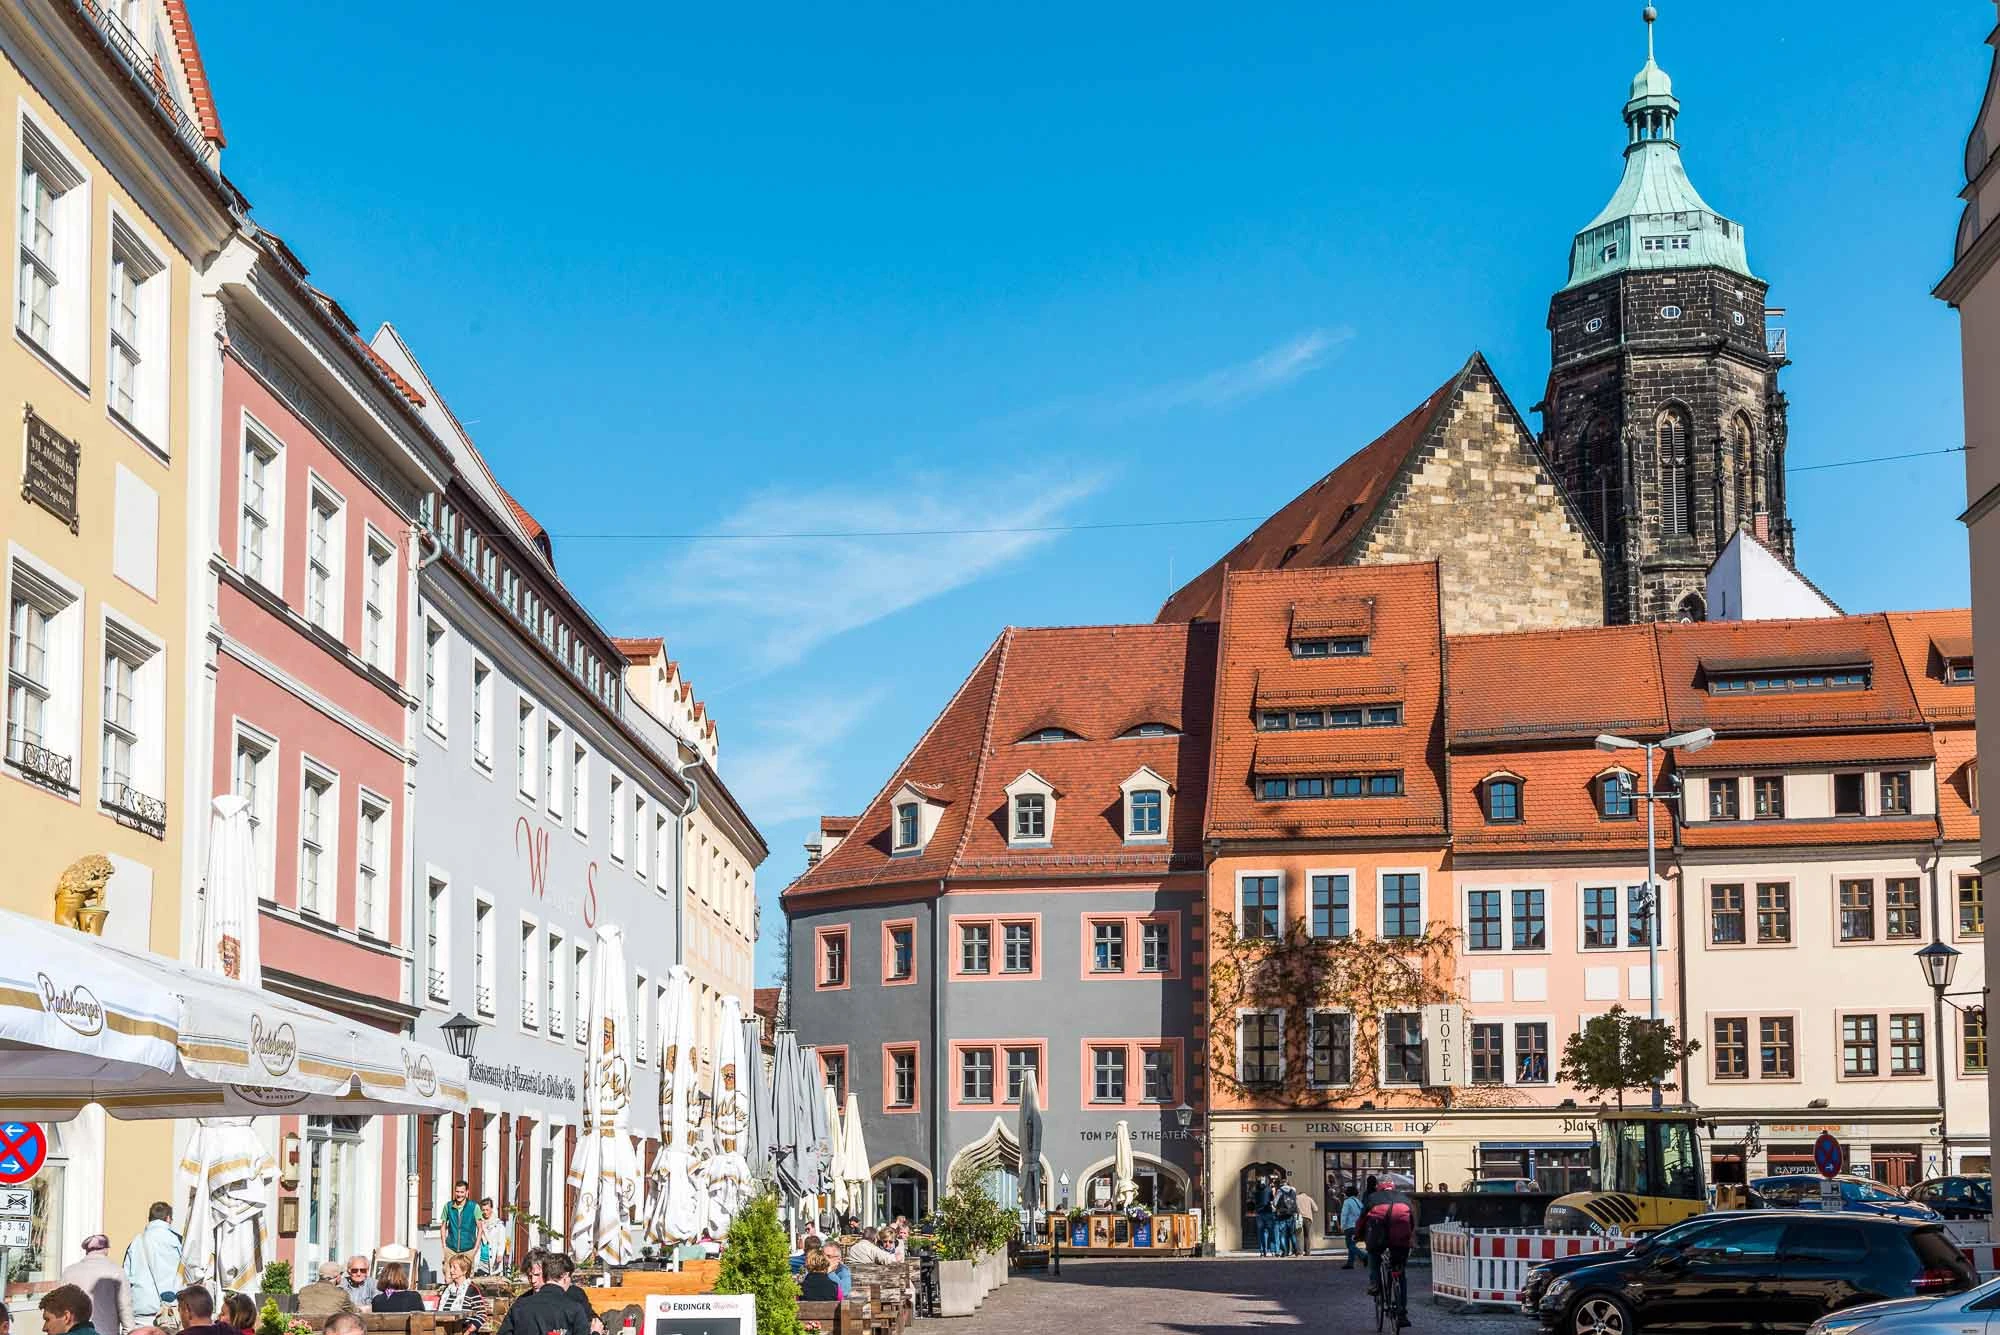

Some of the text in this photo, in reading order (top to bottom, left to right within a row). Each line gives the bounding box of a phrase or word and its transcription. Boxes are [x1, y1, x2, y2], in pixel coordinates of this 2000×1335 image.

[1440, 1008, 1452, 1082] HOTEL
[1241, 1123, 1287, 1133] HOTEL
[1306, 1121, 1393, 1133] PIRN'SCHER
[1080, 1130, 1187, 1141] TOM PAS THEATER
[673, 1302, 711, 1311] ERDINGER
